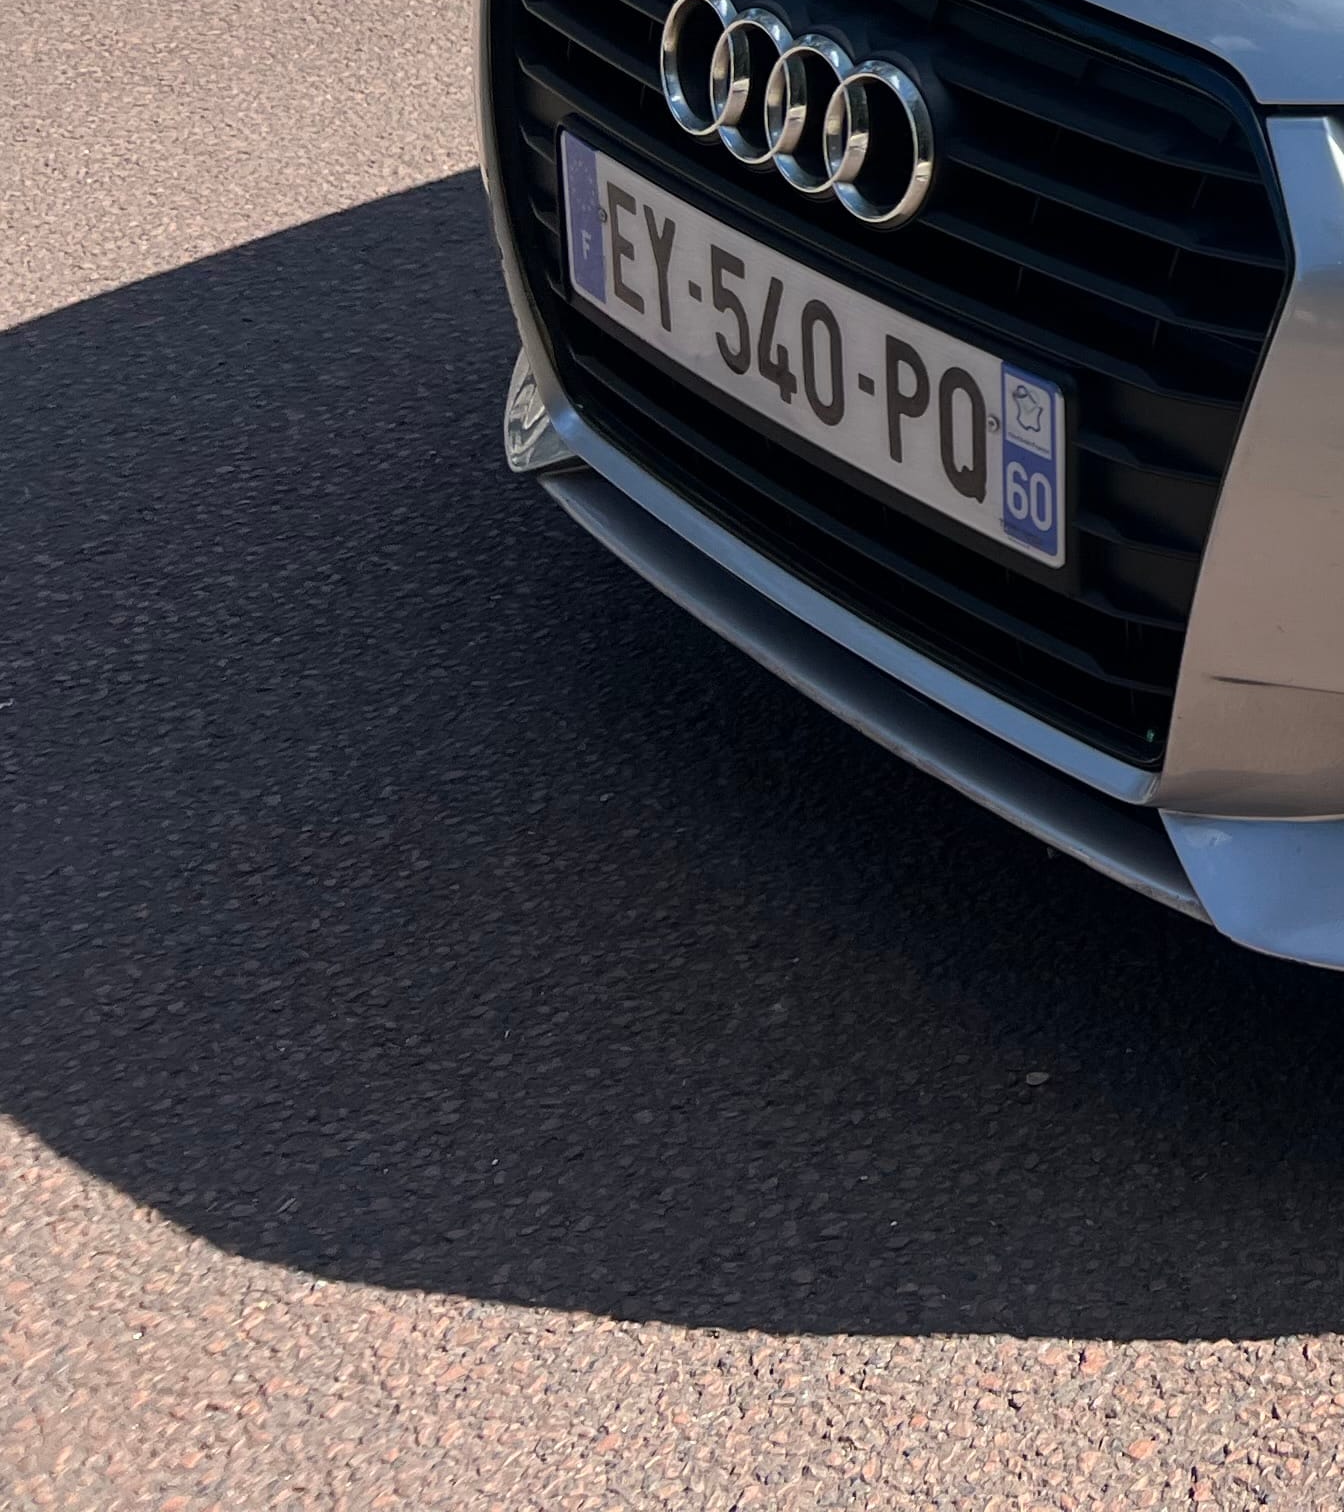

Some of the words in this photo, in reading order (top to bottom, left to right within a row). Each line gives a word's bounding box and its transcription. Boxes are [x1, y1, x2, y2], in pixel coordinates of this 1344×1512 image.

[581, 229, 593, 260] F
[607, 181, 986, 504] EY-540-PQ
[1006, 461, 1052, 531] 60
